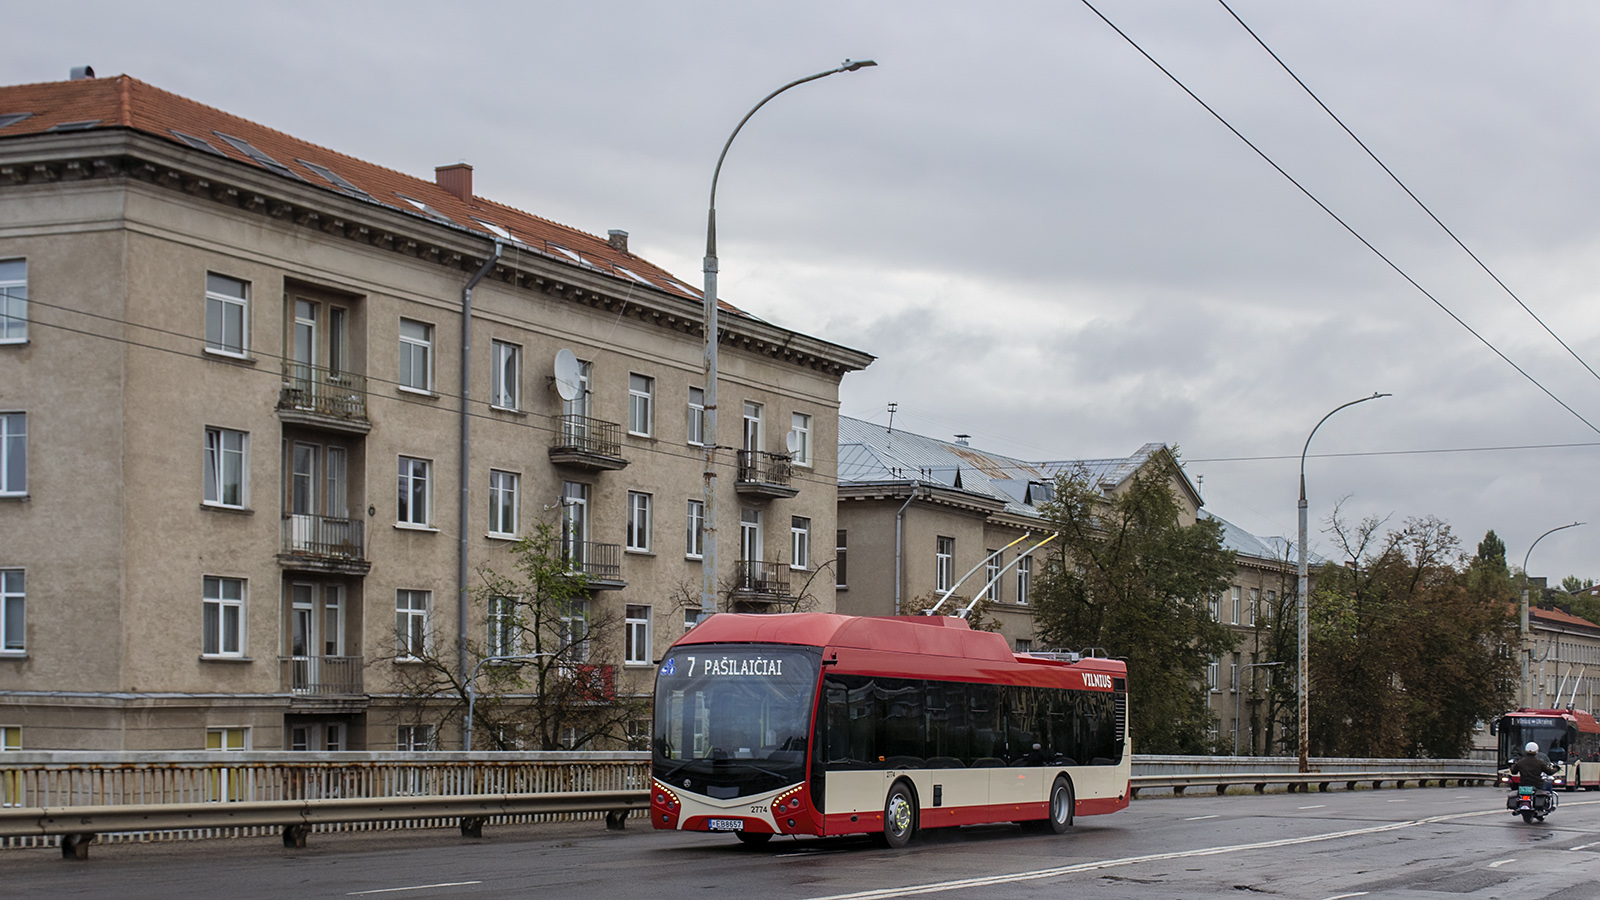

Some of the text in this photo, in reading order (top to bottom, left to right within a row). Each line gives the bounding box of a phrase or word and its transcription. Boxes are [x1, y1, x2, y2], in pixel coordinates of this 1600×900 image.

[687, 656, 782, 677] 7 PAŠILAIČIAI
[1081, 673, 1112, 688] VILNIUS
[750, 805, 768, 814] 2774
